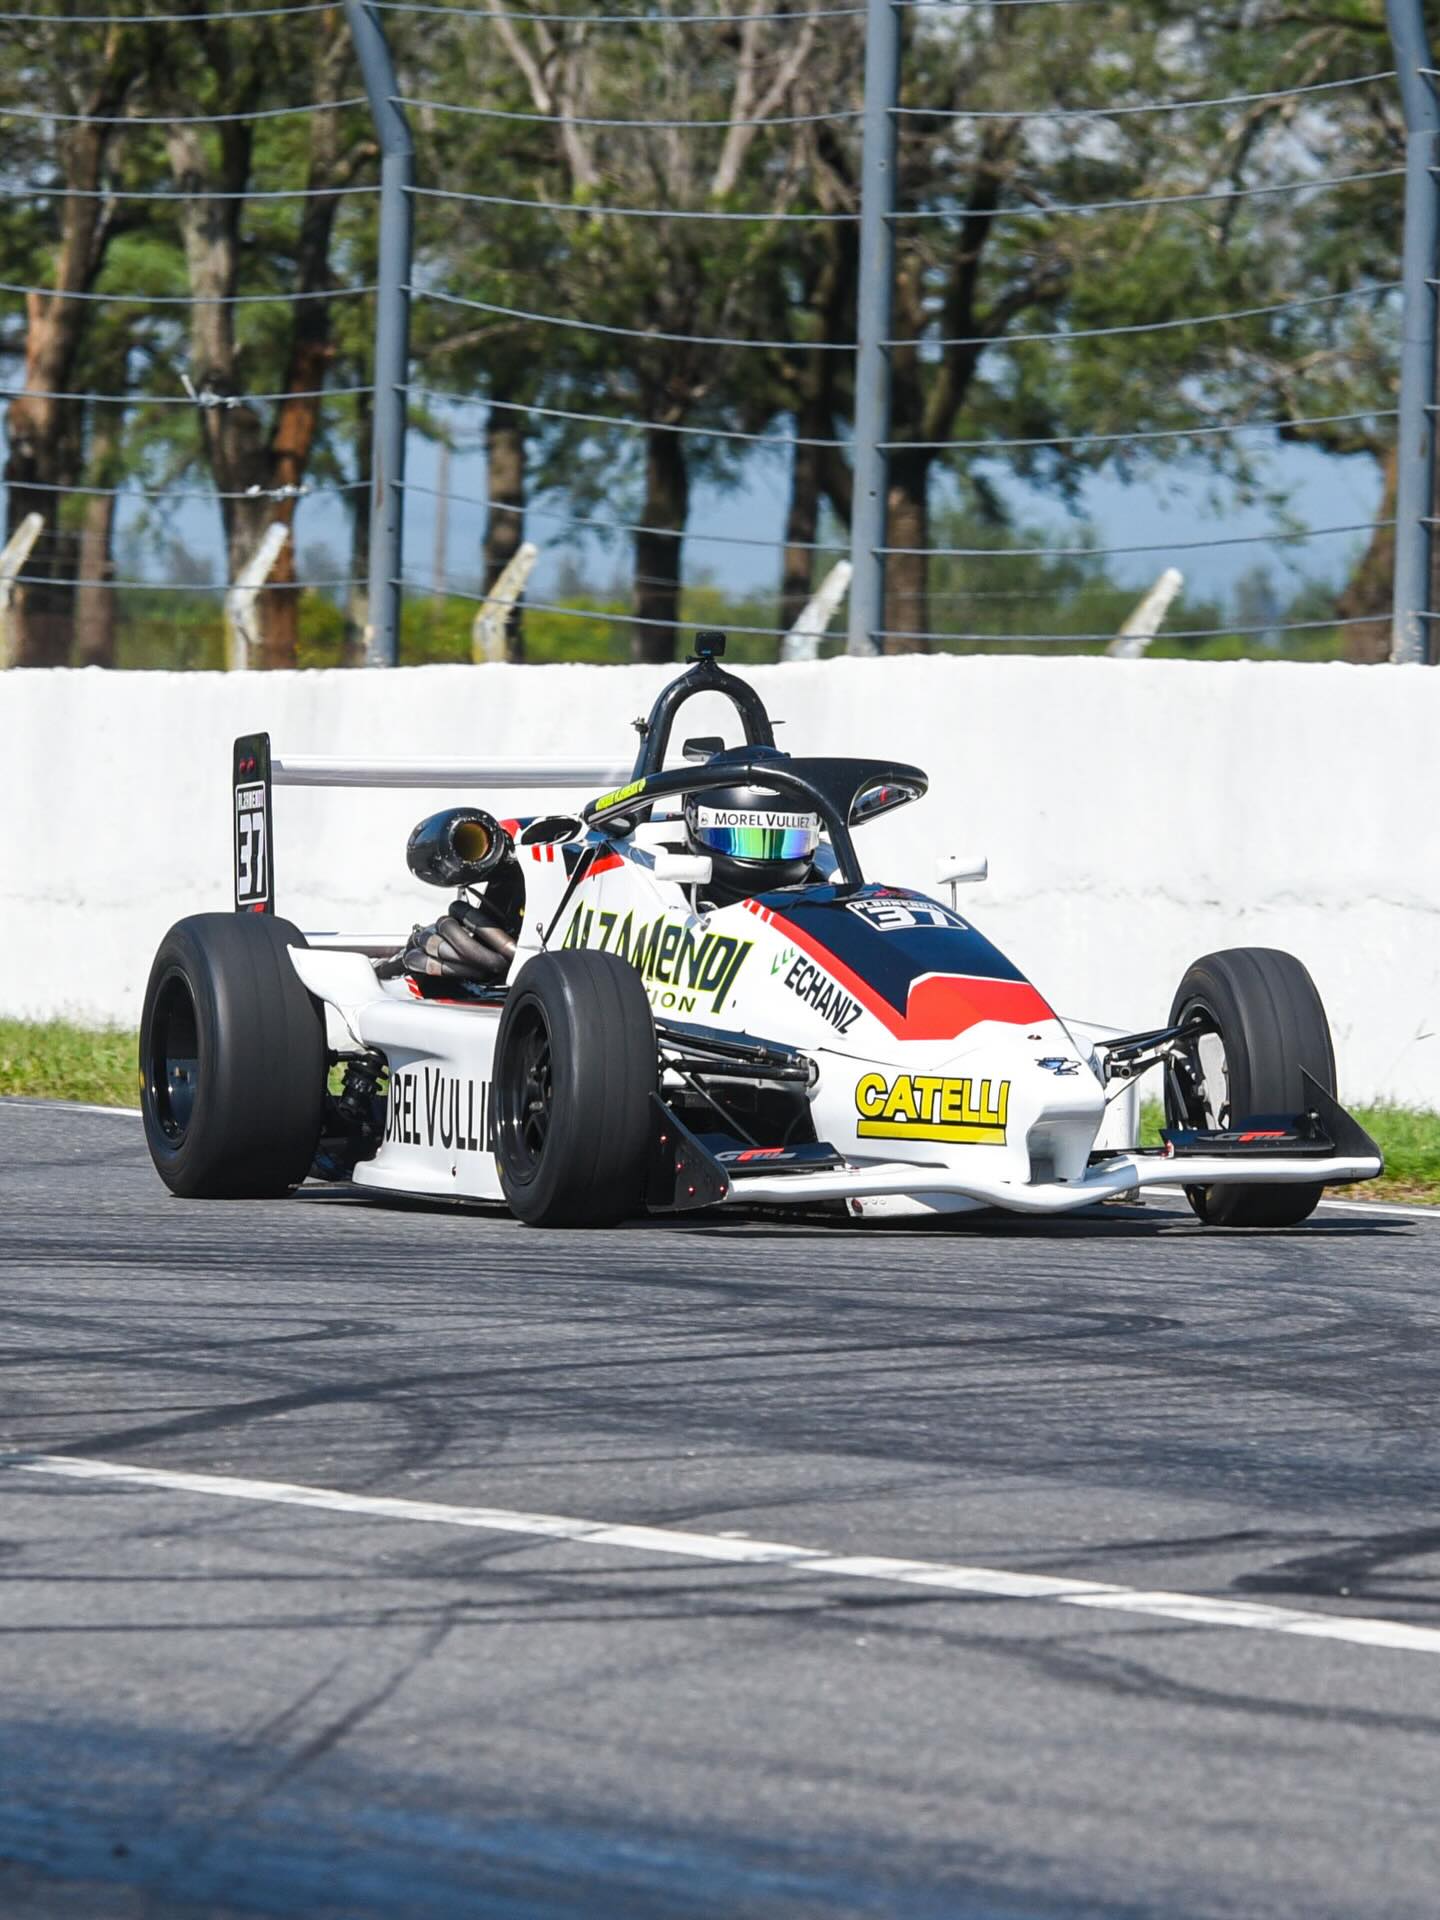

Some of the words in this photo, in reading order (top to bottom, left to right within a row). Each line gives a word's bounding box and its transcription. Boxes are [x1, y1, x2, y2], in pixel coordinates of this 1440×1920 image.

[714, 812, 763, 826] MOREL
[766, 813, 810, 828] VULLIEZ
[239, 812, 264, 895] 37
[866, 906, 949, 928] 37
[647, 986, 697, 1013] ION
[783, 954, 863, 1034] ECHANIZ
[855, 1072, 1011, 1127] CATELLI
